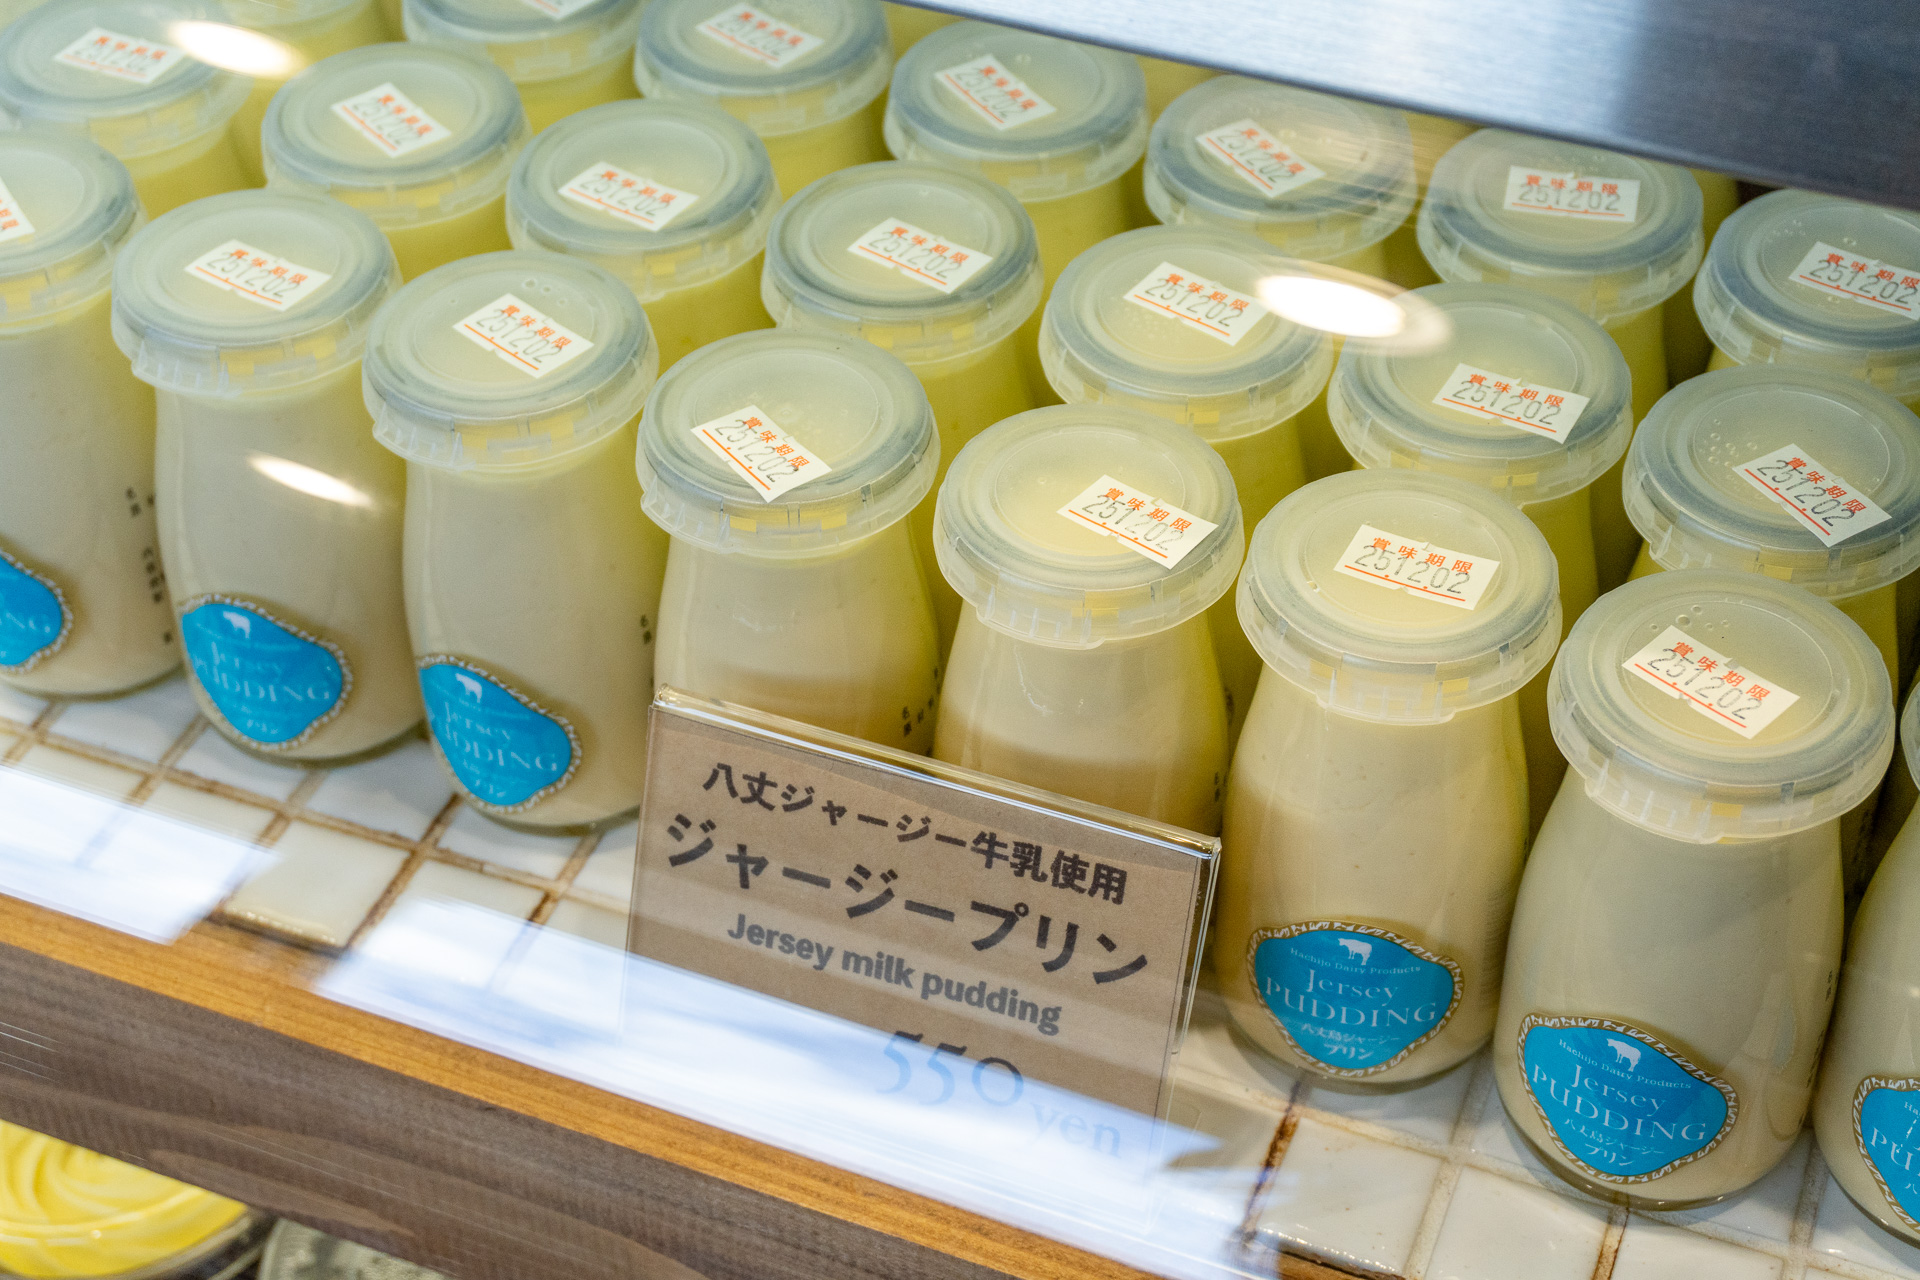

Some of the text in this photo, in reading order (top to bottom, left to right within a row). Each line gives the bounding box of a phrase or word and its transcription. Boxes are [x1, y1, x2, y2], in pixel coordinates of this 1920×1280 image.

[1144, 278, 1244, 328] 251202
[1809, 259, 1919, 305] 251202
[475, 308, 563, 364] 251202
[1452, 380, 1562, 426] 251202
[1469, 373, 1565, 408] 賞味期限
[714, 419, 800, 483] 251202
[743, 416, 811, 468] 賞味期限
[1105, 487, 1192, 532] 賞味期限
[1756, 459, 1856, 527] 251202
[1787, 457, 1867, 514] 賞味期限
[1081, 494, 1185, 551] 251202
[1354, 544, 1471, 594] 251202
[1372, 536, 1474, 574] 賞味期限
[1647, 648, 1762, 720] 251202
[1673, 641, 1771, 702] 賞味期限
[703, 762, 1127, 905] 八丈ジャージー牛乳使用
[667, 813, 1148, 985] ジャージープリン
[727, 913, 1061, 1036] Jersey milk pudding
[1290, 947, 1421, 975] Hachijo Dairy Products
[1265, 976, 1437, 1028] PUDDING
[1306, 969, 1399, 1007] Jersey
[877, 1030, 1024, 1107] 550
[1323, 1042, 1374, 1060] プリン
[1558, 1038, 1692, 1089] Hachijo Dairy Products
[1532, 1063, 1707, 1141] PUDDING
[1571, 1063, 1666, 1117] Jersey
[1584, 1143, 1635, 1167] プリン
